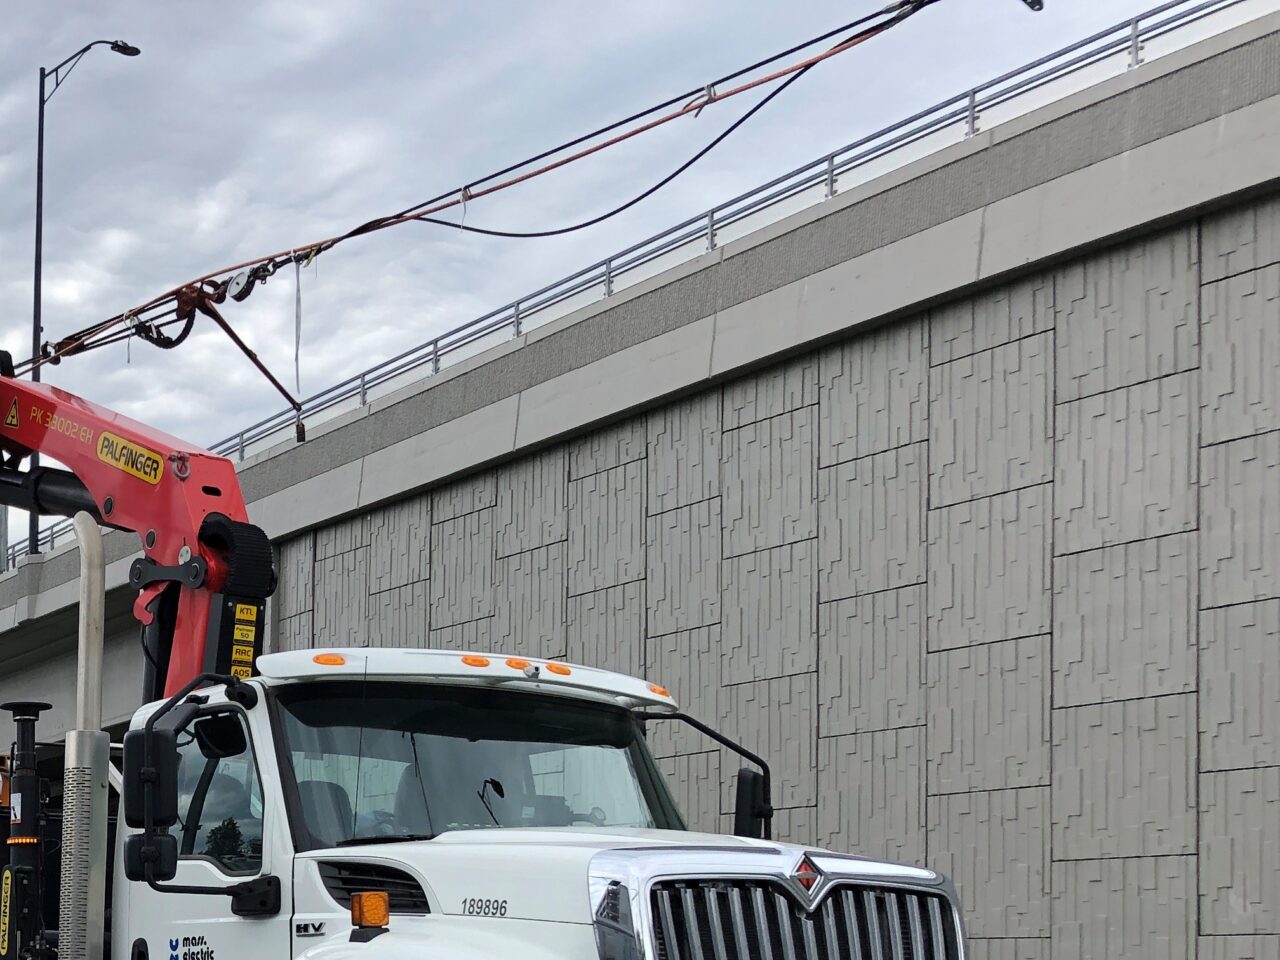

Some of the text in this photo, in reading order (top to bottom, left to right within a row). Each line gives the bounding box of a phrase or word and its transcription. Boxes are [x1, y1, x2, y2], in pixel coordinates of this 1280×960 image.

[29, 406, 44, 425] PK
[99, 435, 160, 480] PALFINGER
[239, 607, 254, 616] KTL
[233, 668, 250, 678] AOS
[1, 875, 10, 950] PALFINGER
[460, 897, 508, 917] 189896
[295, 921, 326, 935] HV
[182, 935, 207, 948] mass.
